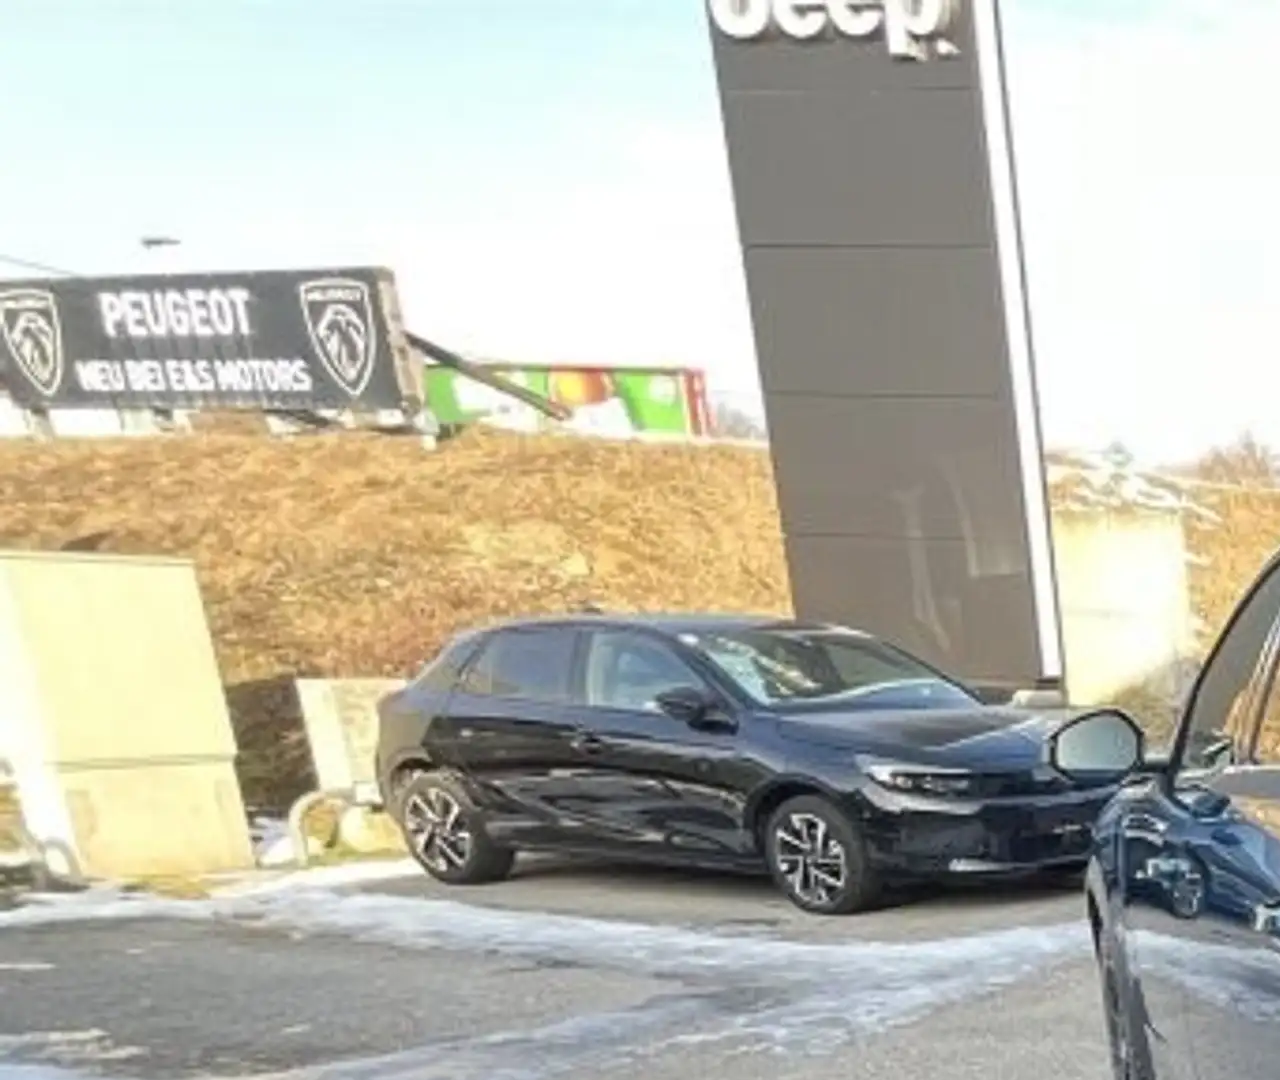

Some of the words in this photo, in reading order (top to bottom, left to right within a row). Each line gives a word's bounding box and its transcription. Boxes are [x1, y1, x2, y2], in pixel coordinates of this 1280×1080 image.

[100, 289, 253, 337] PEUGEOT
[76, 361, 122, 390] NEU
[126, 361, 165, 391] BEI
[216, 359, 312, 391] MOTORS
